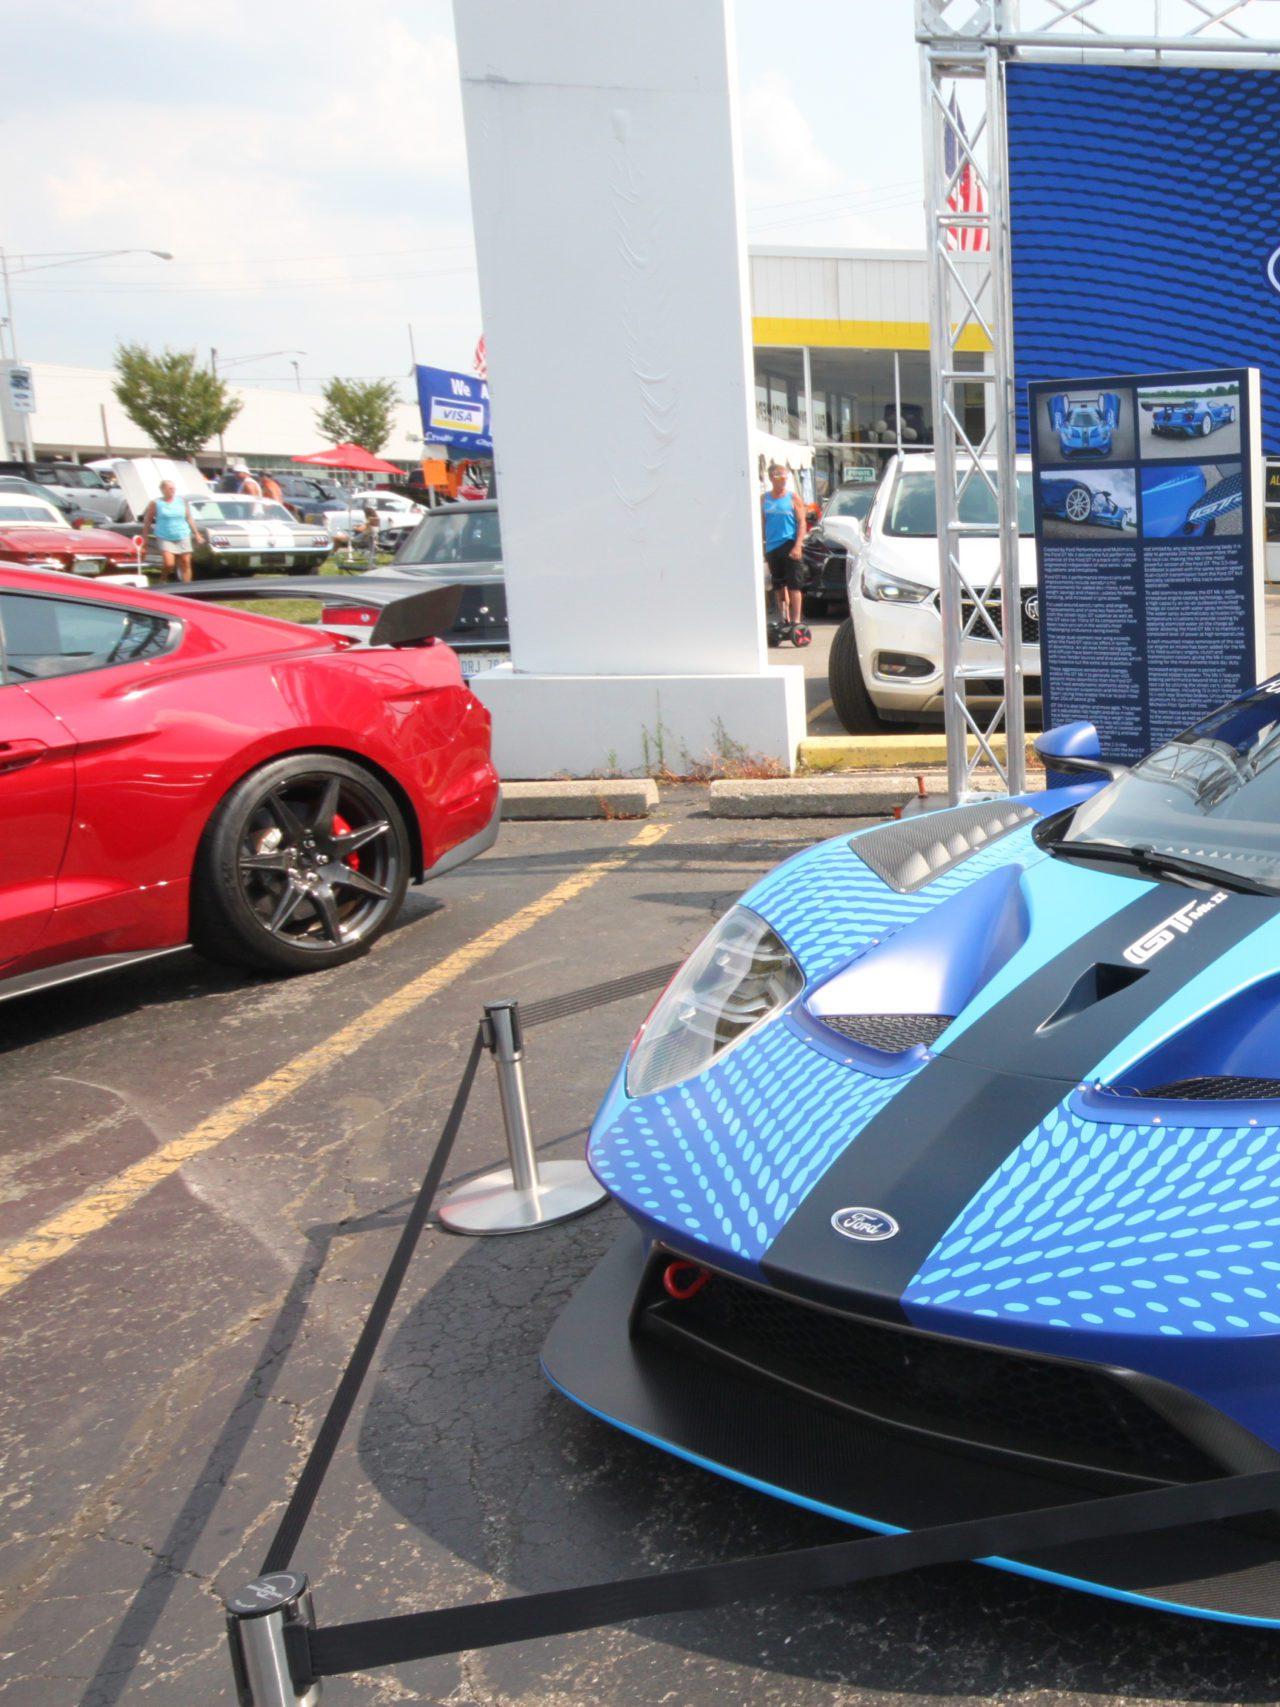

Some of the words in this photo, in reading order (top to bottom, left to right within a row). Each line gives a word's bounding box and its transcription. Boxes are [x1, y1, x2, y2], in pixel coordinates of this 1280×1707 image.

[450, 378, 471, 398] We
[443, 409, 473, 423] VISA
[1122, 899, 1198, 965] GT
[843, 1212, 884, 1235] Ford
